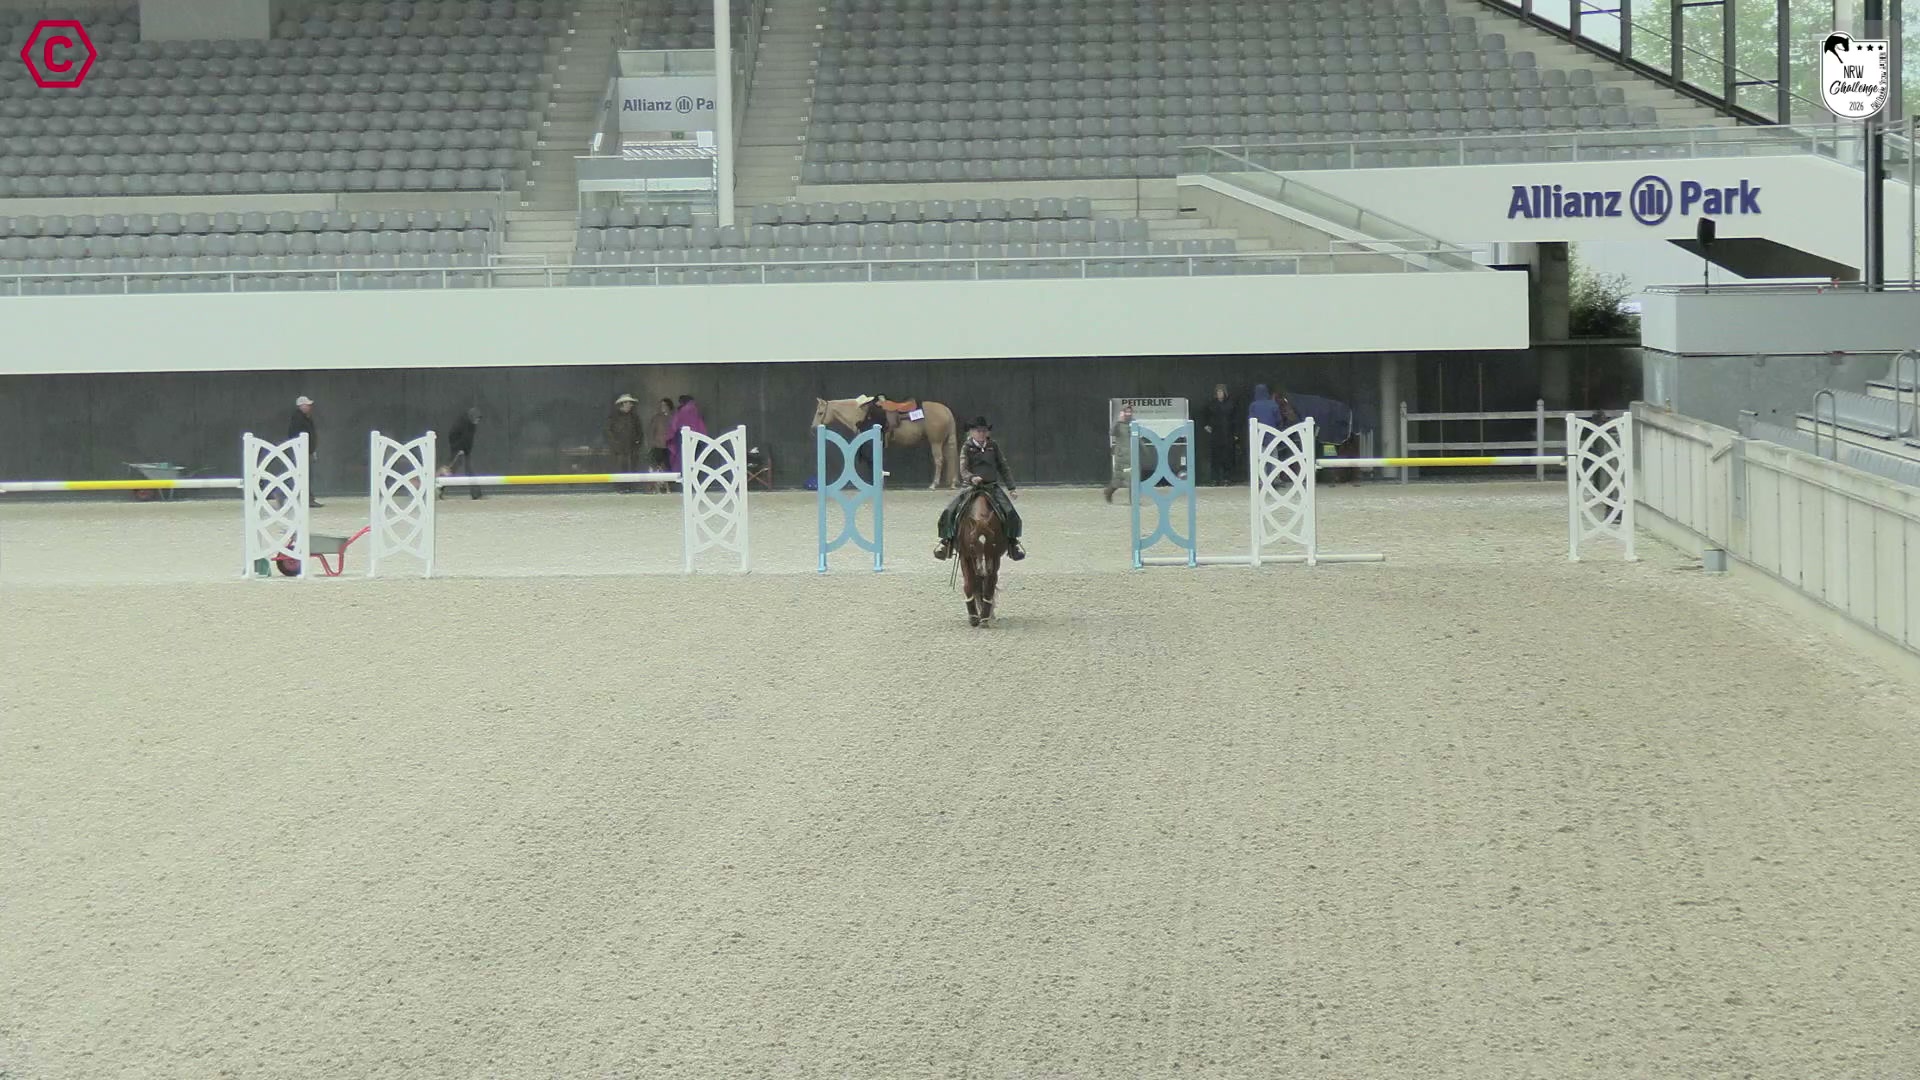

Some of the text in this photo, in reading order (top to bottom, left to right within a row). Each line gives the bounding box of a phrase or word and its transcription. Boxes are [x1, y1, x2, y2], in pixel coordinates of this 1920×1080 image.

[623, 98, 672, 111] Allianz
[696, 98, 716, 110] Pa
[1508, 180, 1761, 219] Allianz Park
